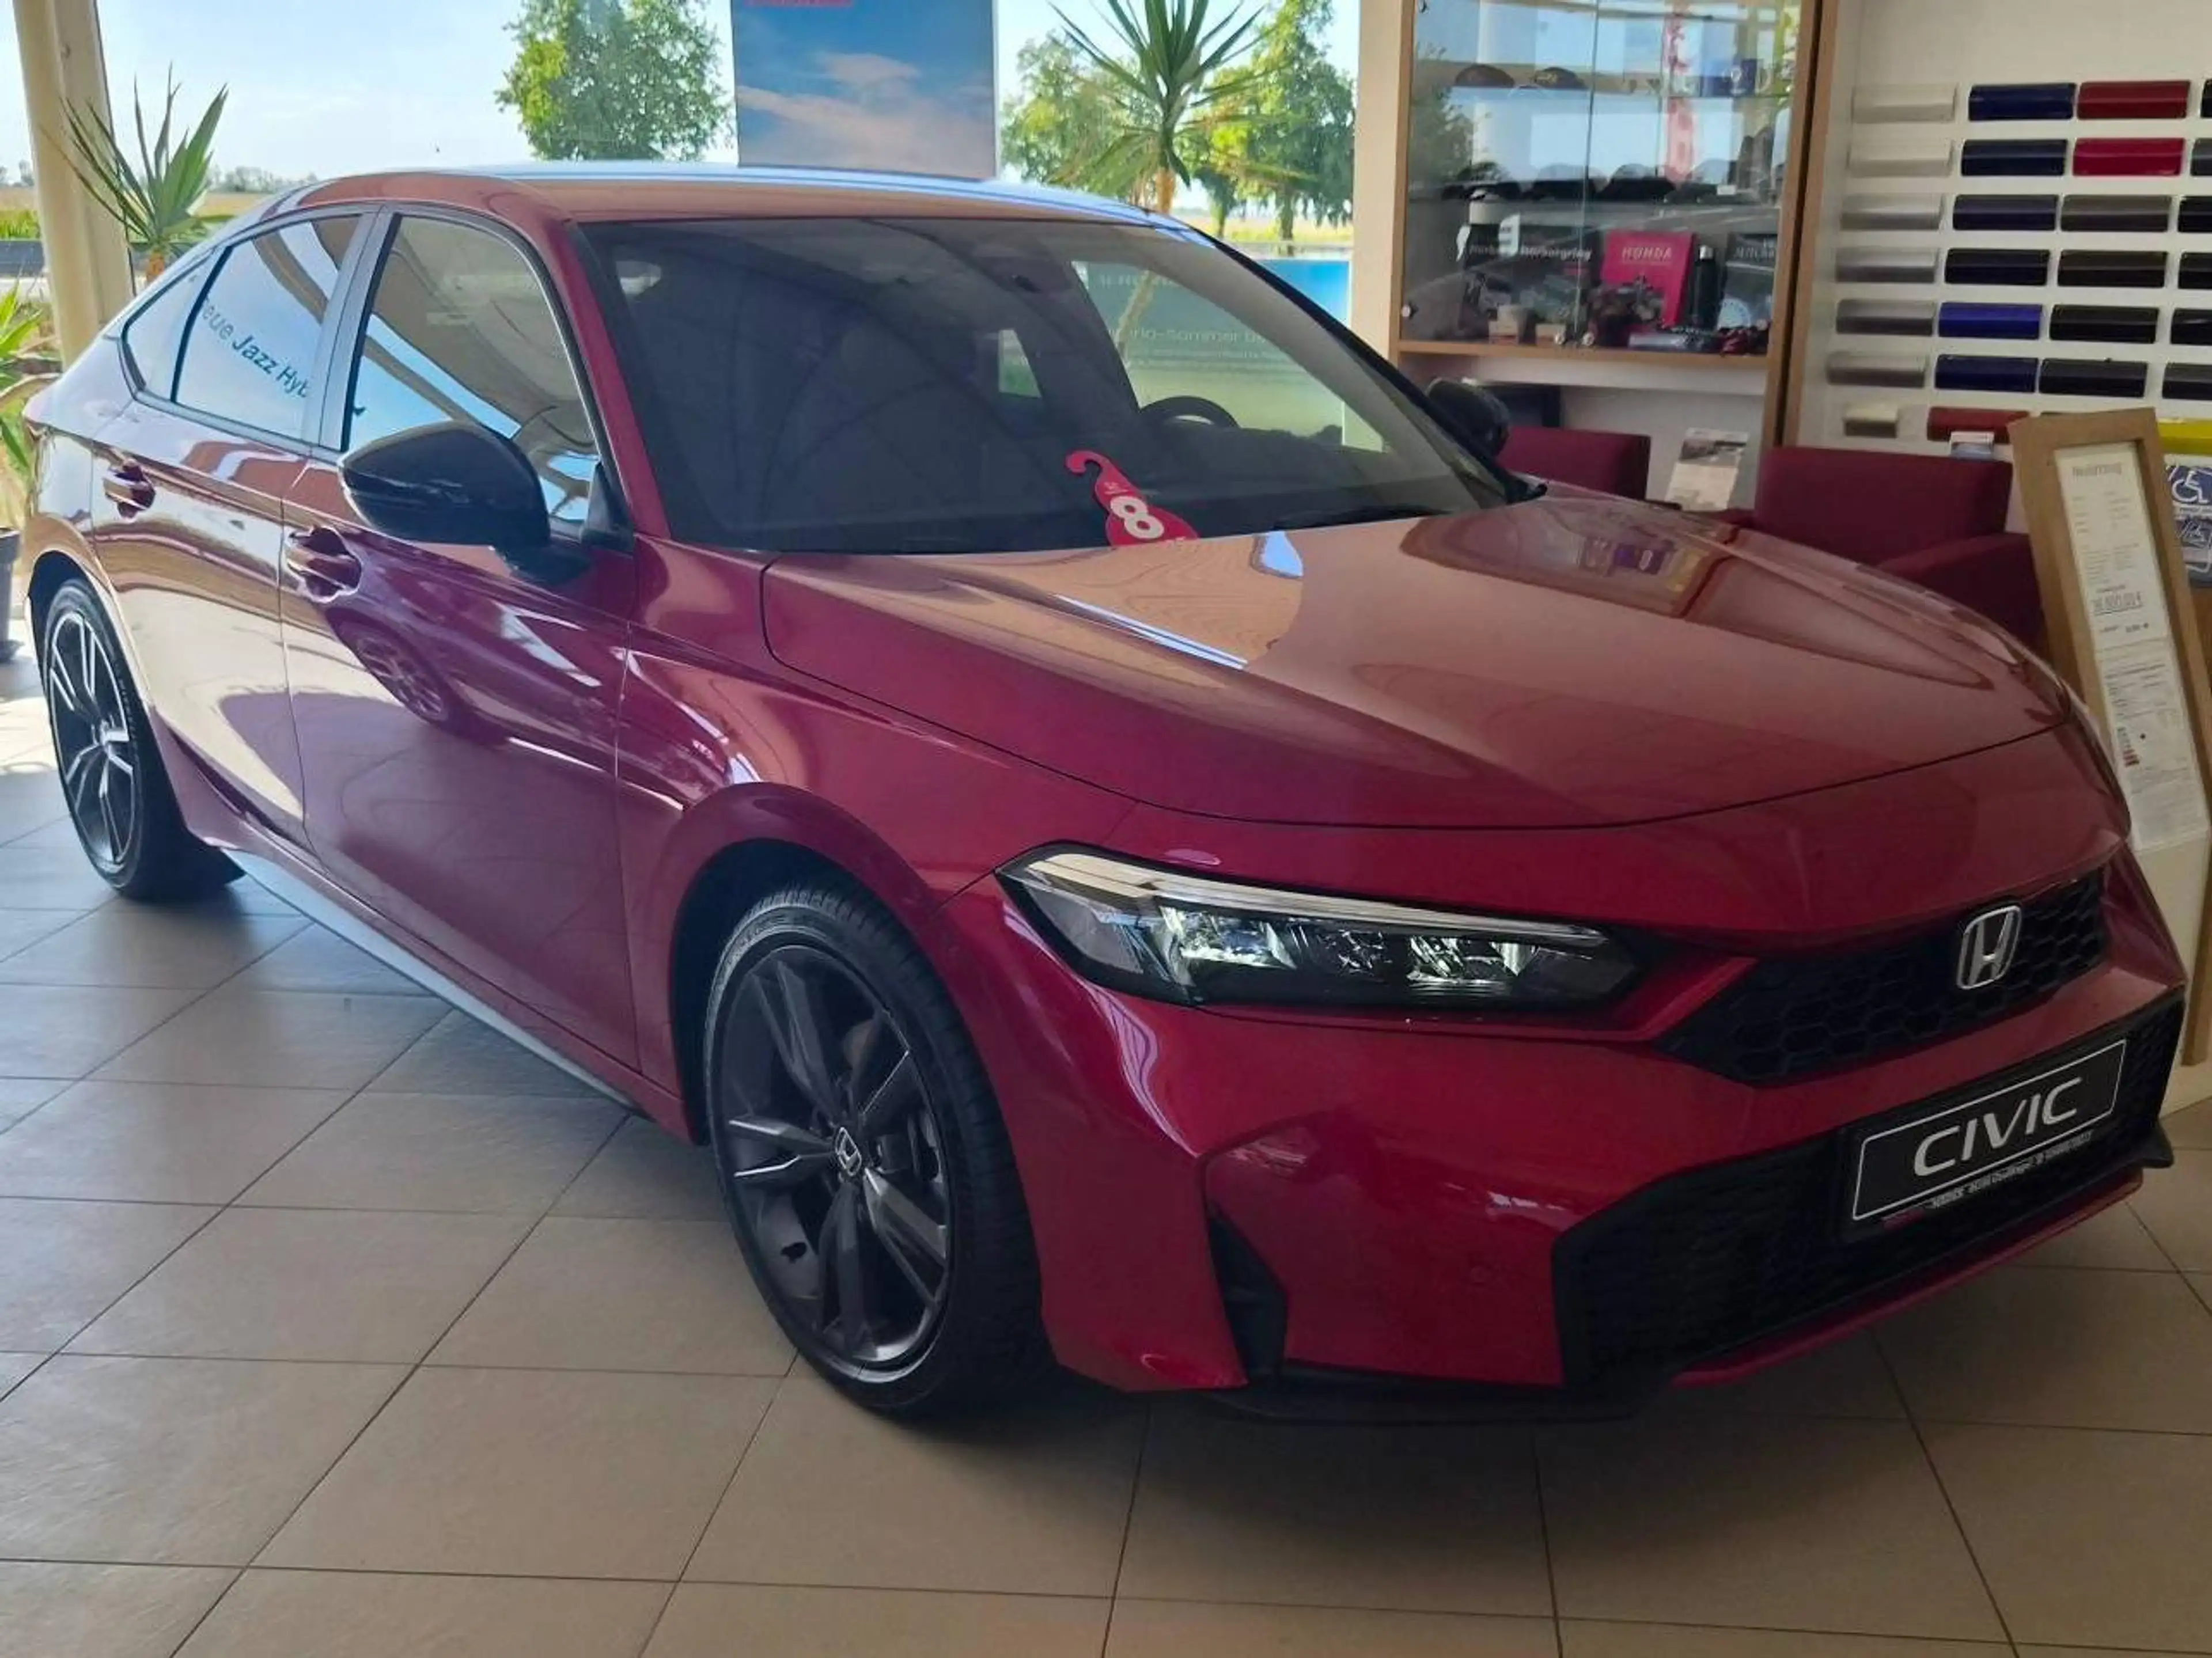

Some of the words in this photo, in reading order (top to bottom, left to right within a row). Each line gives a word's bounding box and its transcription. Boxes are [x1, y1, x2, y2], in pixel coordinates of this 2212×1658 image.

[1622, 246, 1673, 261] HONDA
[203, 295, 234, 340] eue
[232, 335, 278, 374] Jazz
[1110, 496, 1164, 539] 8
[1914, 1076, 2082, 1176] CIVIC
